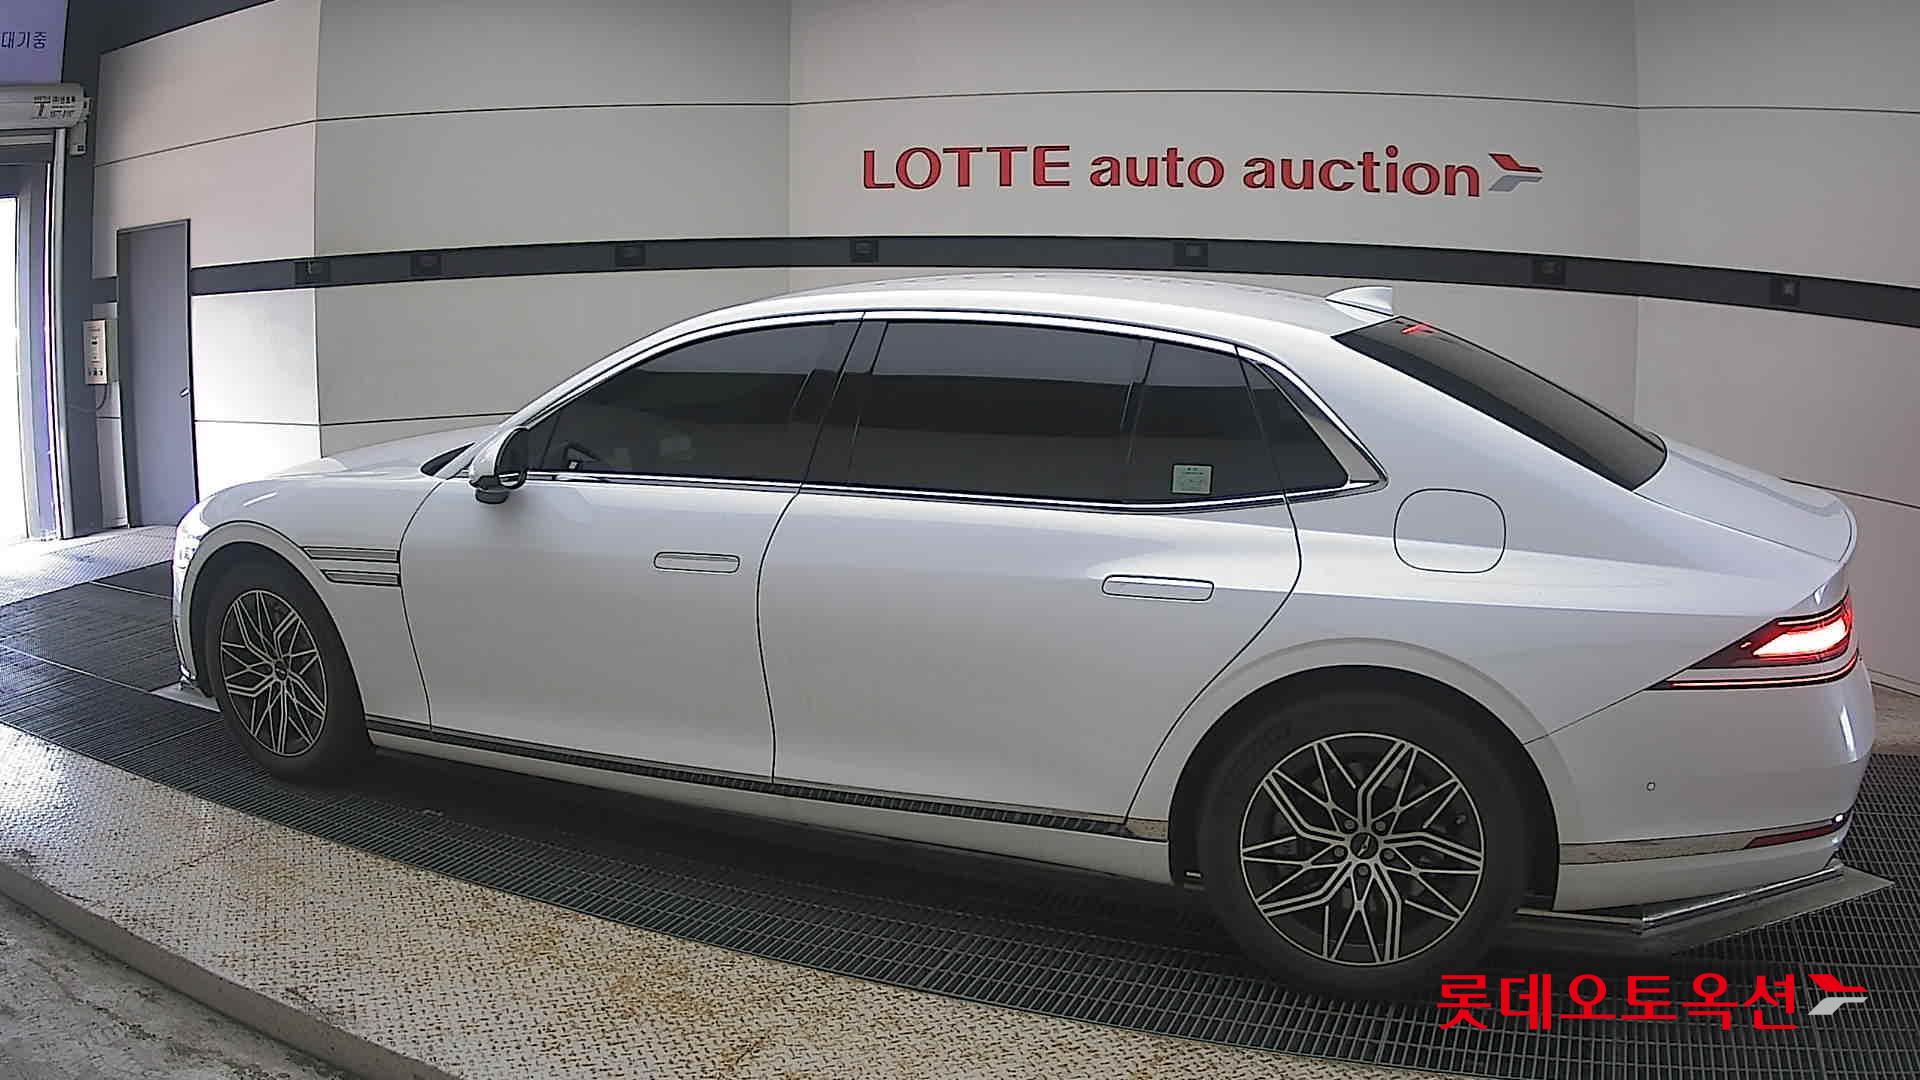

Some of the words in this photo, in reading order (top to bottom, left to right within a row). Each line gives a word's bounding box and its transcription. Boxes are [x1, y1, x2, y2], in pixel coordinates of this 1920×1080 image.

[1, 31, 48, 49] 대기중
[863, 144, 1070, 190] LOTTE
[1088, 147, 1226, 188] auto
[1242, 145, 1481, 198] auction
